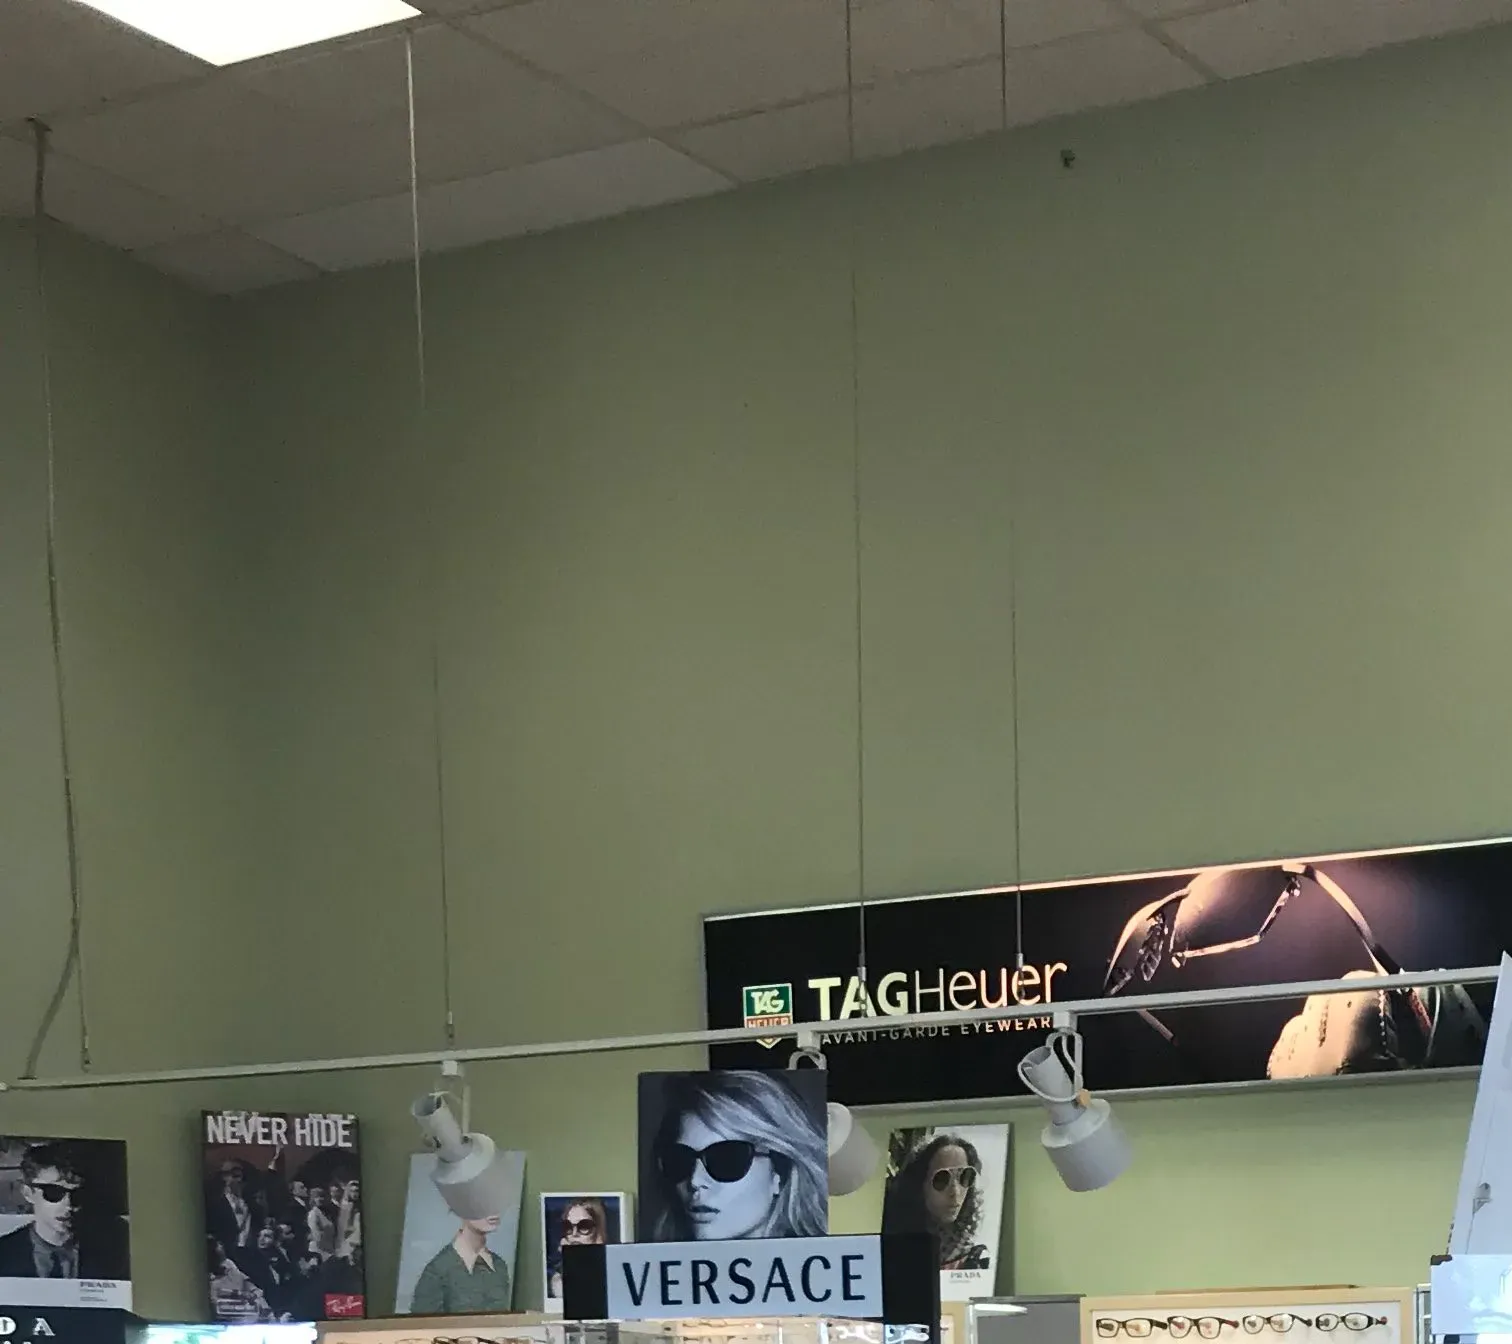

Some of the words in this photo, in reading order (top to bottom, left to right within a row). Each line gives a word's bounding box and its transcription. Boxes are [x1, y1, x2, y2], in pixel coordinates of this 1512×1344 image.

[751, 989, 784, 1014] TAG
[960, 1016, 1051, 1035] EYEWEAR
[206, 1115, 288, 1145] NEVER
[294, 1117, 353, 1148] HIDE
[621, 1254, 866, 1306] VERSACE
